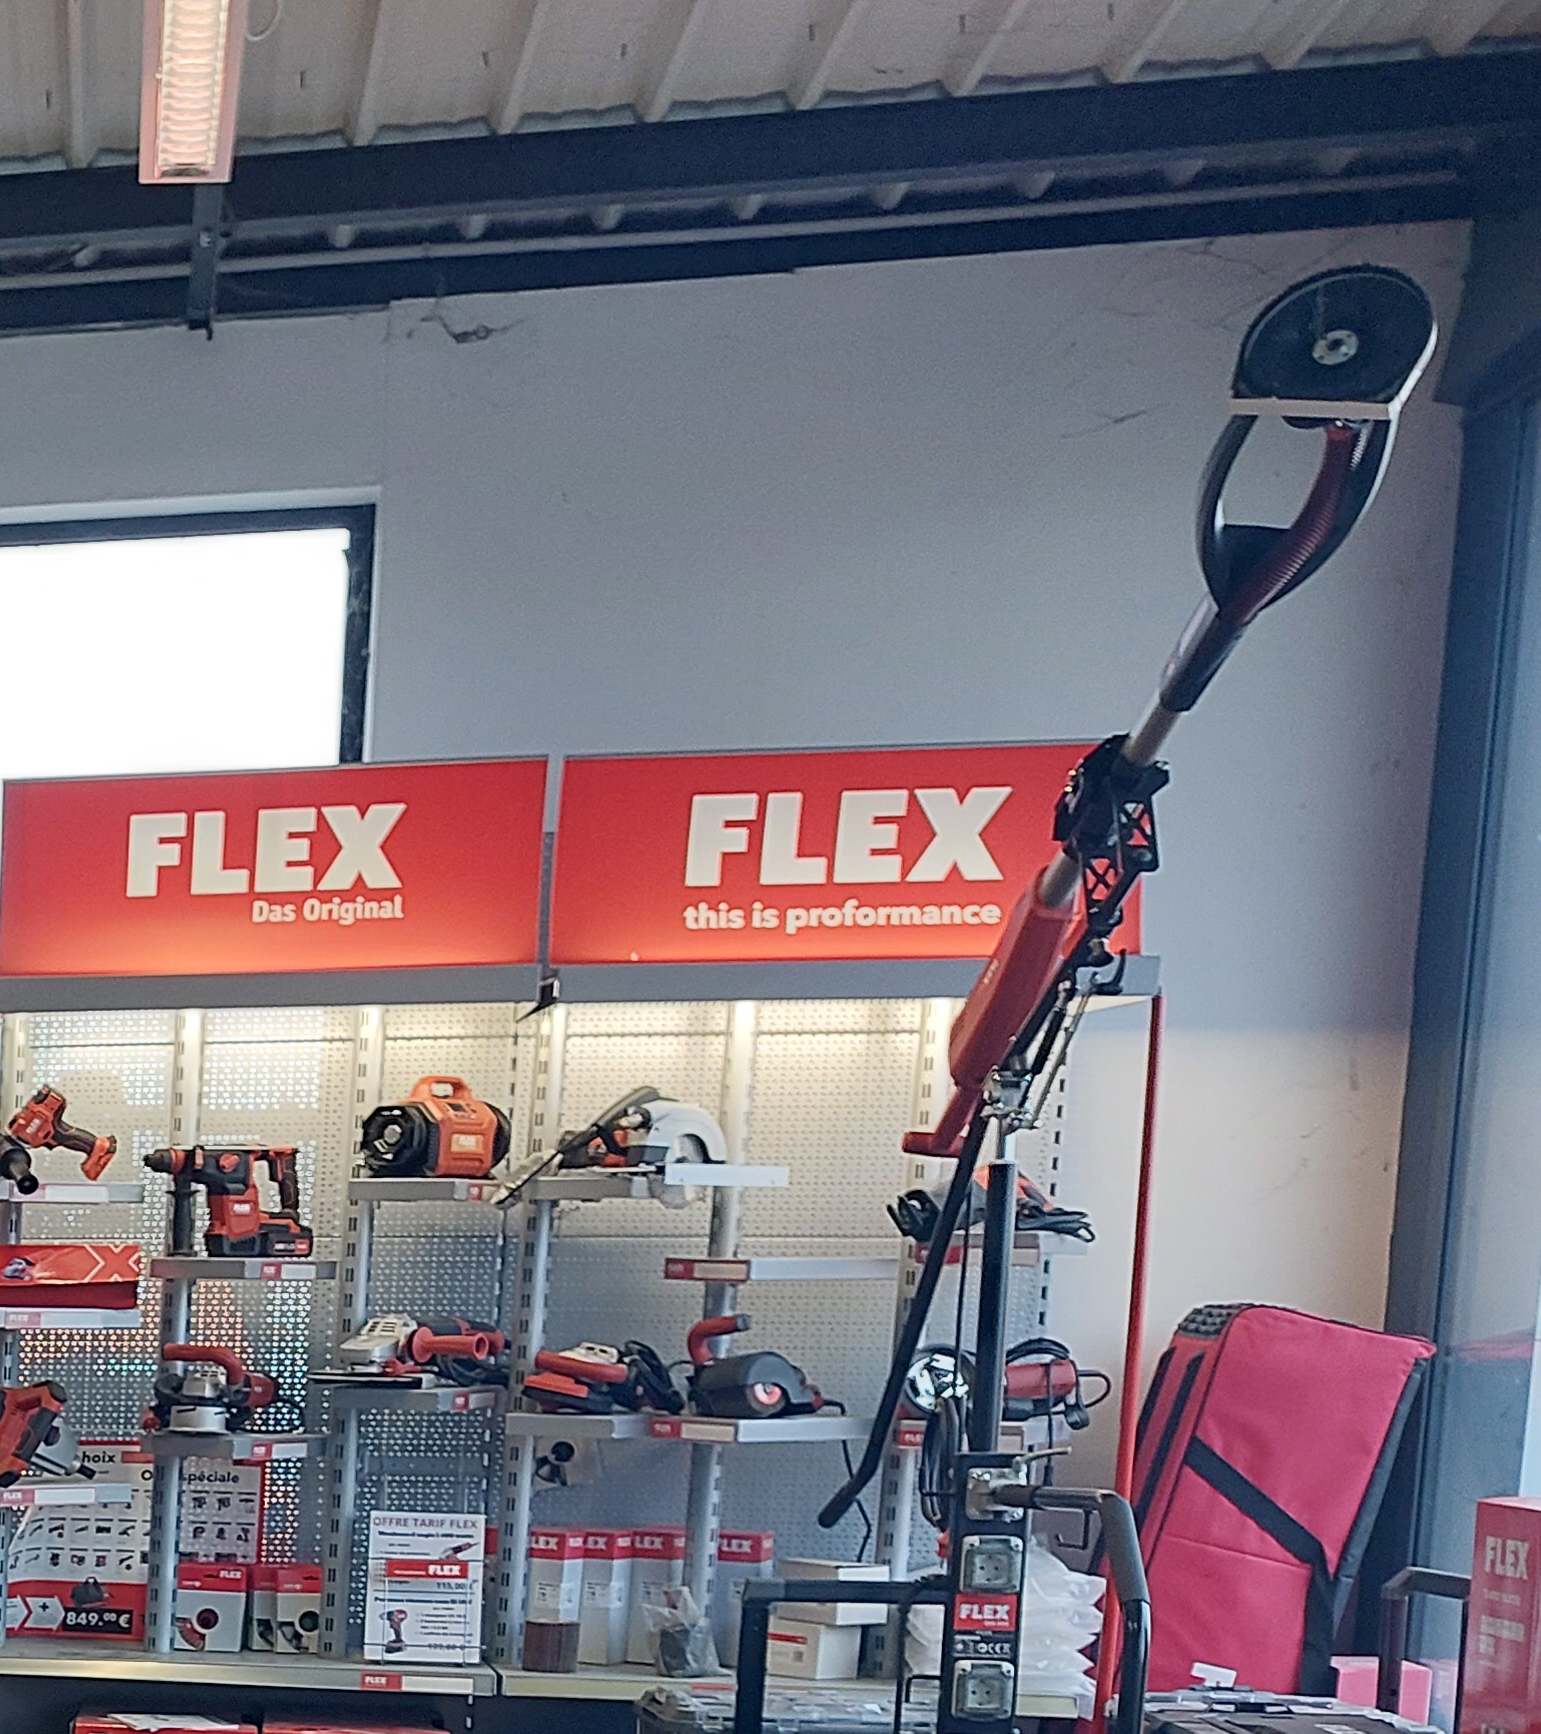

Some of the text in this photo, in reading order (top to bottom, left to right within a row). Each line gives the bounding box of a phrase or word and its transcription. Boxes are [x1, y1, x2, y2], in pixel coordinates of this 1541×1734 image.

[684, 786, 1012, 887] FLEX
[126, 803, 407, 899] FLEX
[251, 892, 406, 927] Das Original
[682, 897, 1001, 933] this is proformance
[82, 1452, 115, 1464] hoix
[373, 1517, 478, 1529] OFFRE TARIF FLEX
[428, 1565, 460, 1576] FLEX
[1483, 1537, 1528, 1581] FLEX
[119, 1613, 131, 1628] €
[959, 1603, 1011, 1620] FLEX
